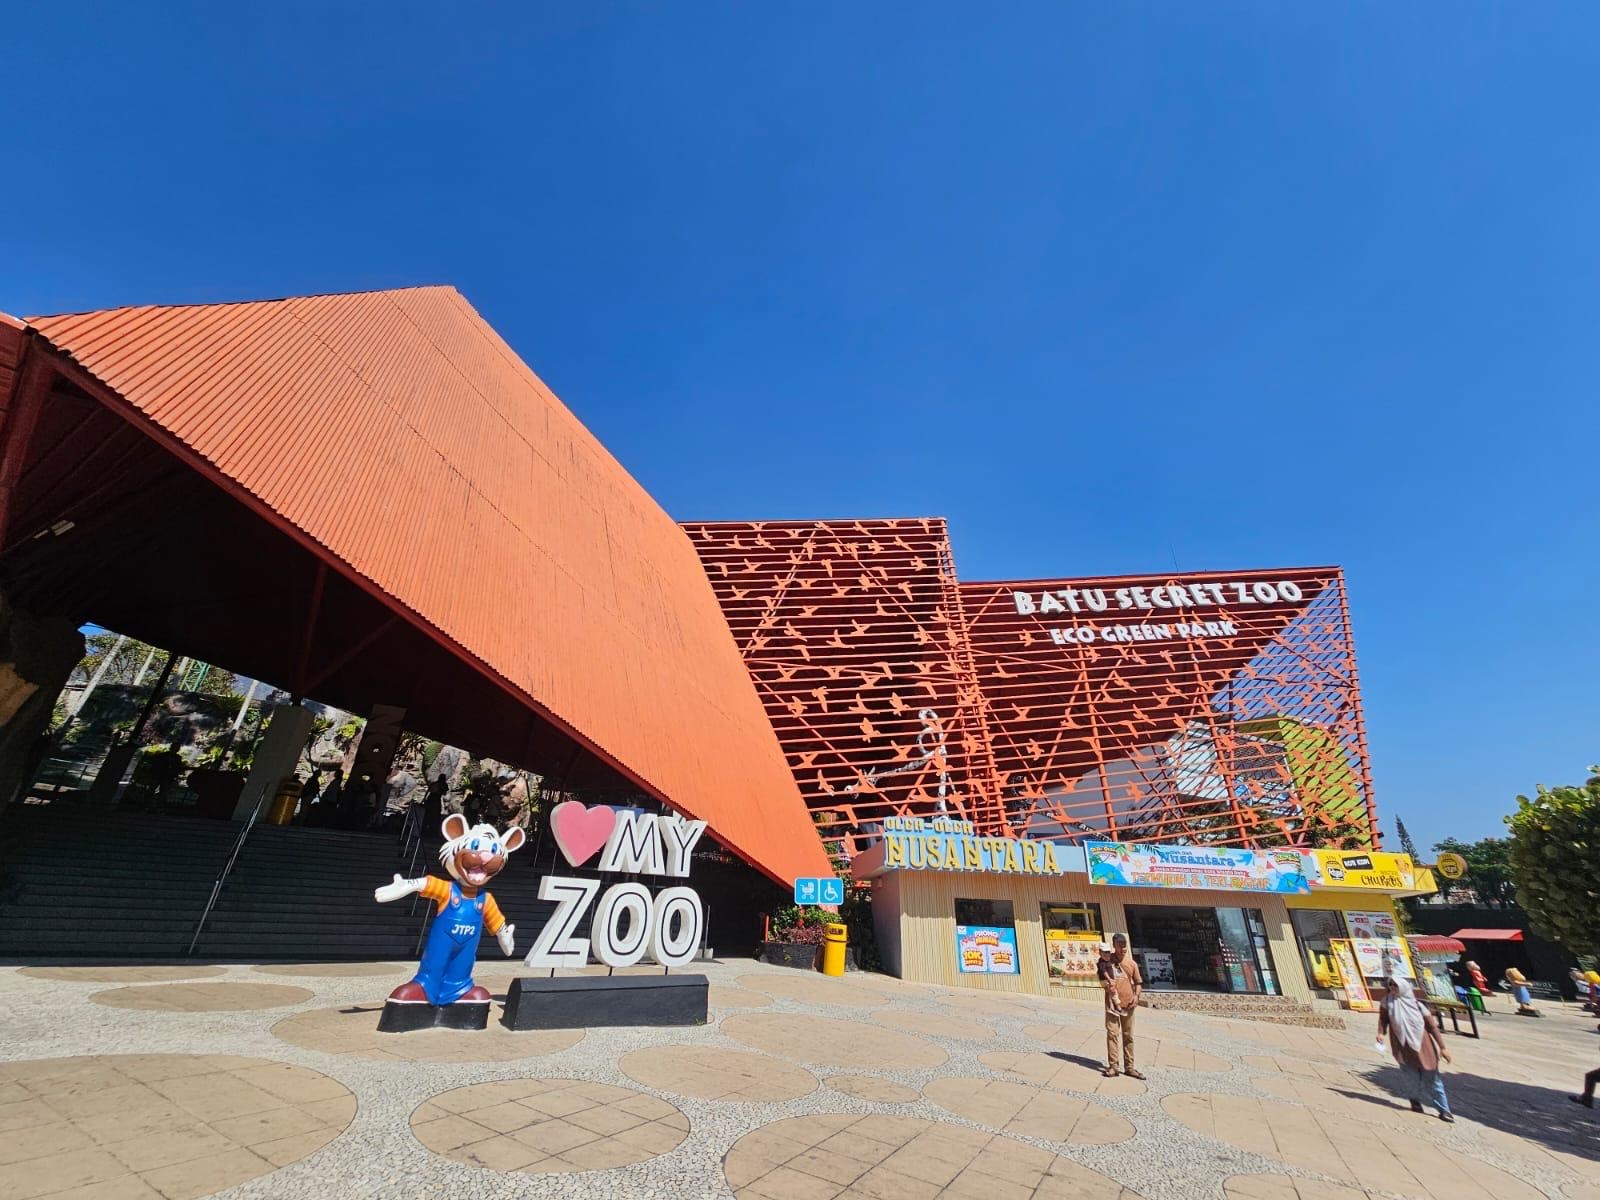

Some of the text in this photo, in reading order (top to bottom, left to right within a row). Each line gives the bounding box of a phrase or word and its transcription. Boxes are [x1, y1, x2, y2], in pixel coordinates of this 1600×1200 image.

[1013, 580, 1302, 616] BATU SECRET ZOO
[1050, 620, 1238, 645] ECO GREEN PARK
[885, 817, 974, 834] OLEH-OLEH
[598, 810, 707, 877] MY
[885, 834, 1063, 876] NUSANTARA
[1160, 851, 1236, 867] Nusantara
[451, 923, 476, 936] JTP2
[525, 876, 704, 968] ZOO
